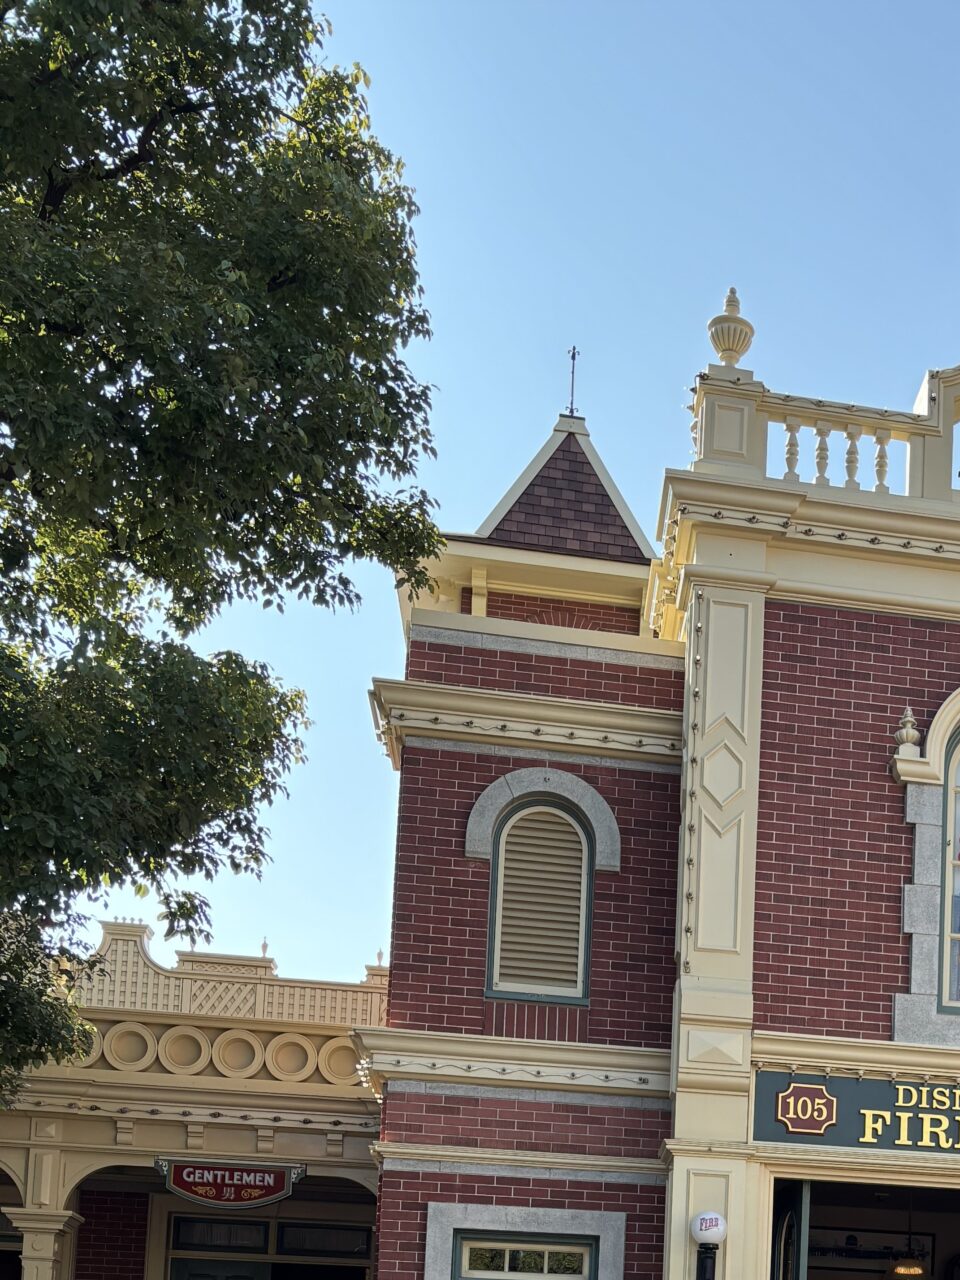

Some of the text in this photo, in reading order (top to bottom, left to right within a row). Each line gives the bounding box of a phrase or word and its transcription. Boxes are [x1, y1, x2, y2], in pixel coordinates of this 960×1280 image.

[785, 1096, 828, 1121] 105
[182, 1167, 275, 1187] GENTLEMEN
[699, 1217, 719, 1231] FIRE
